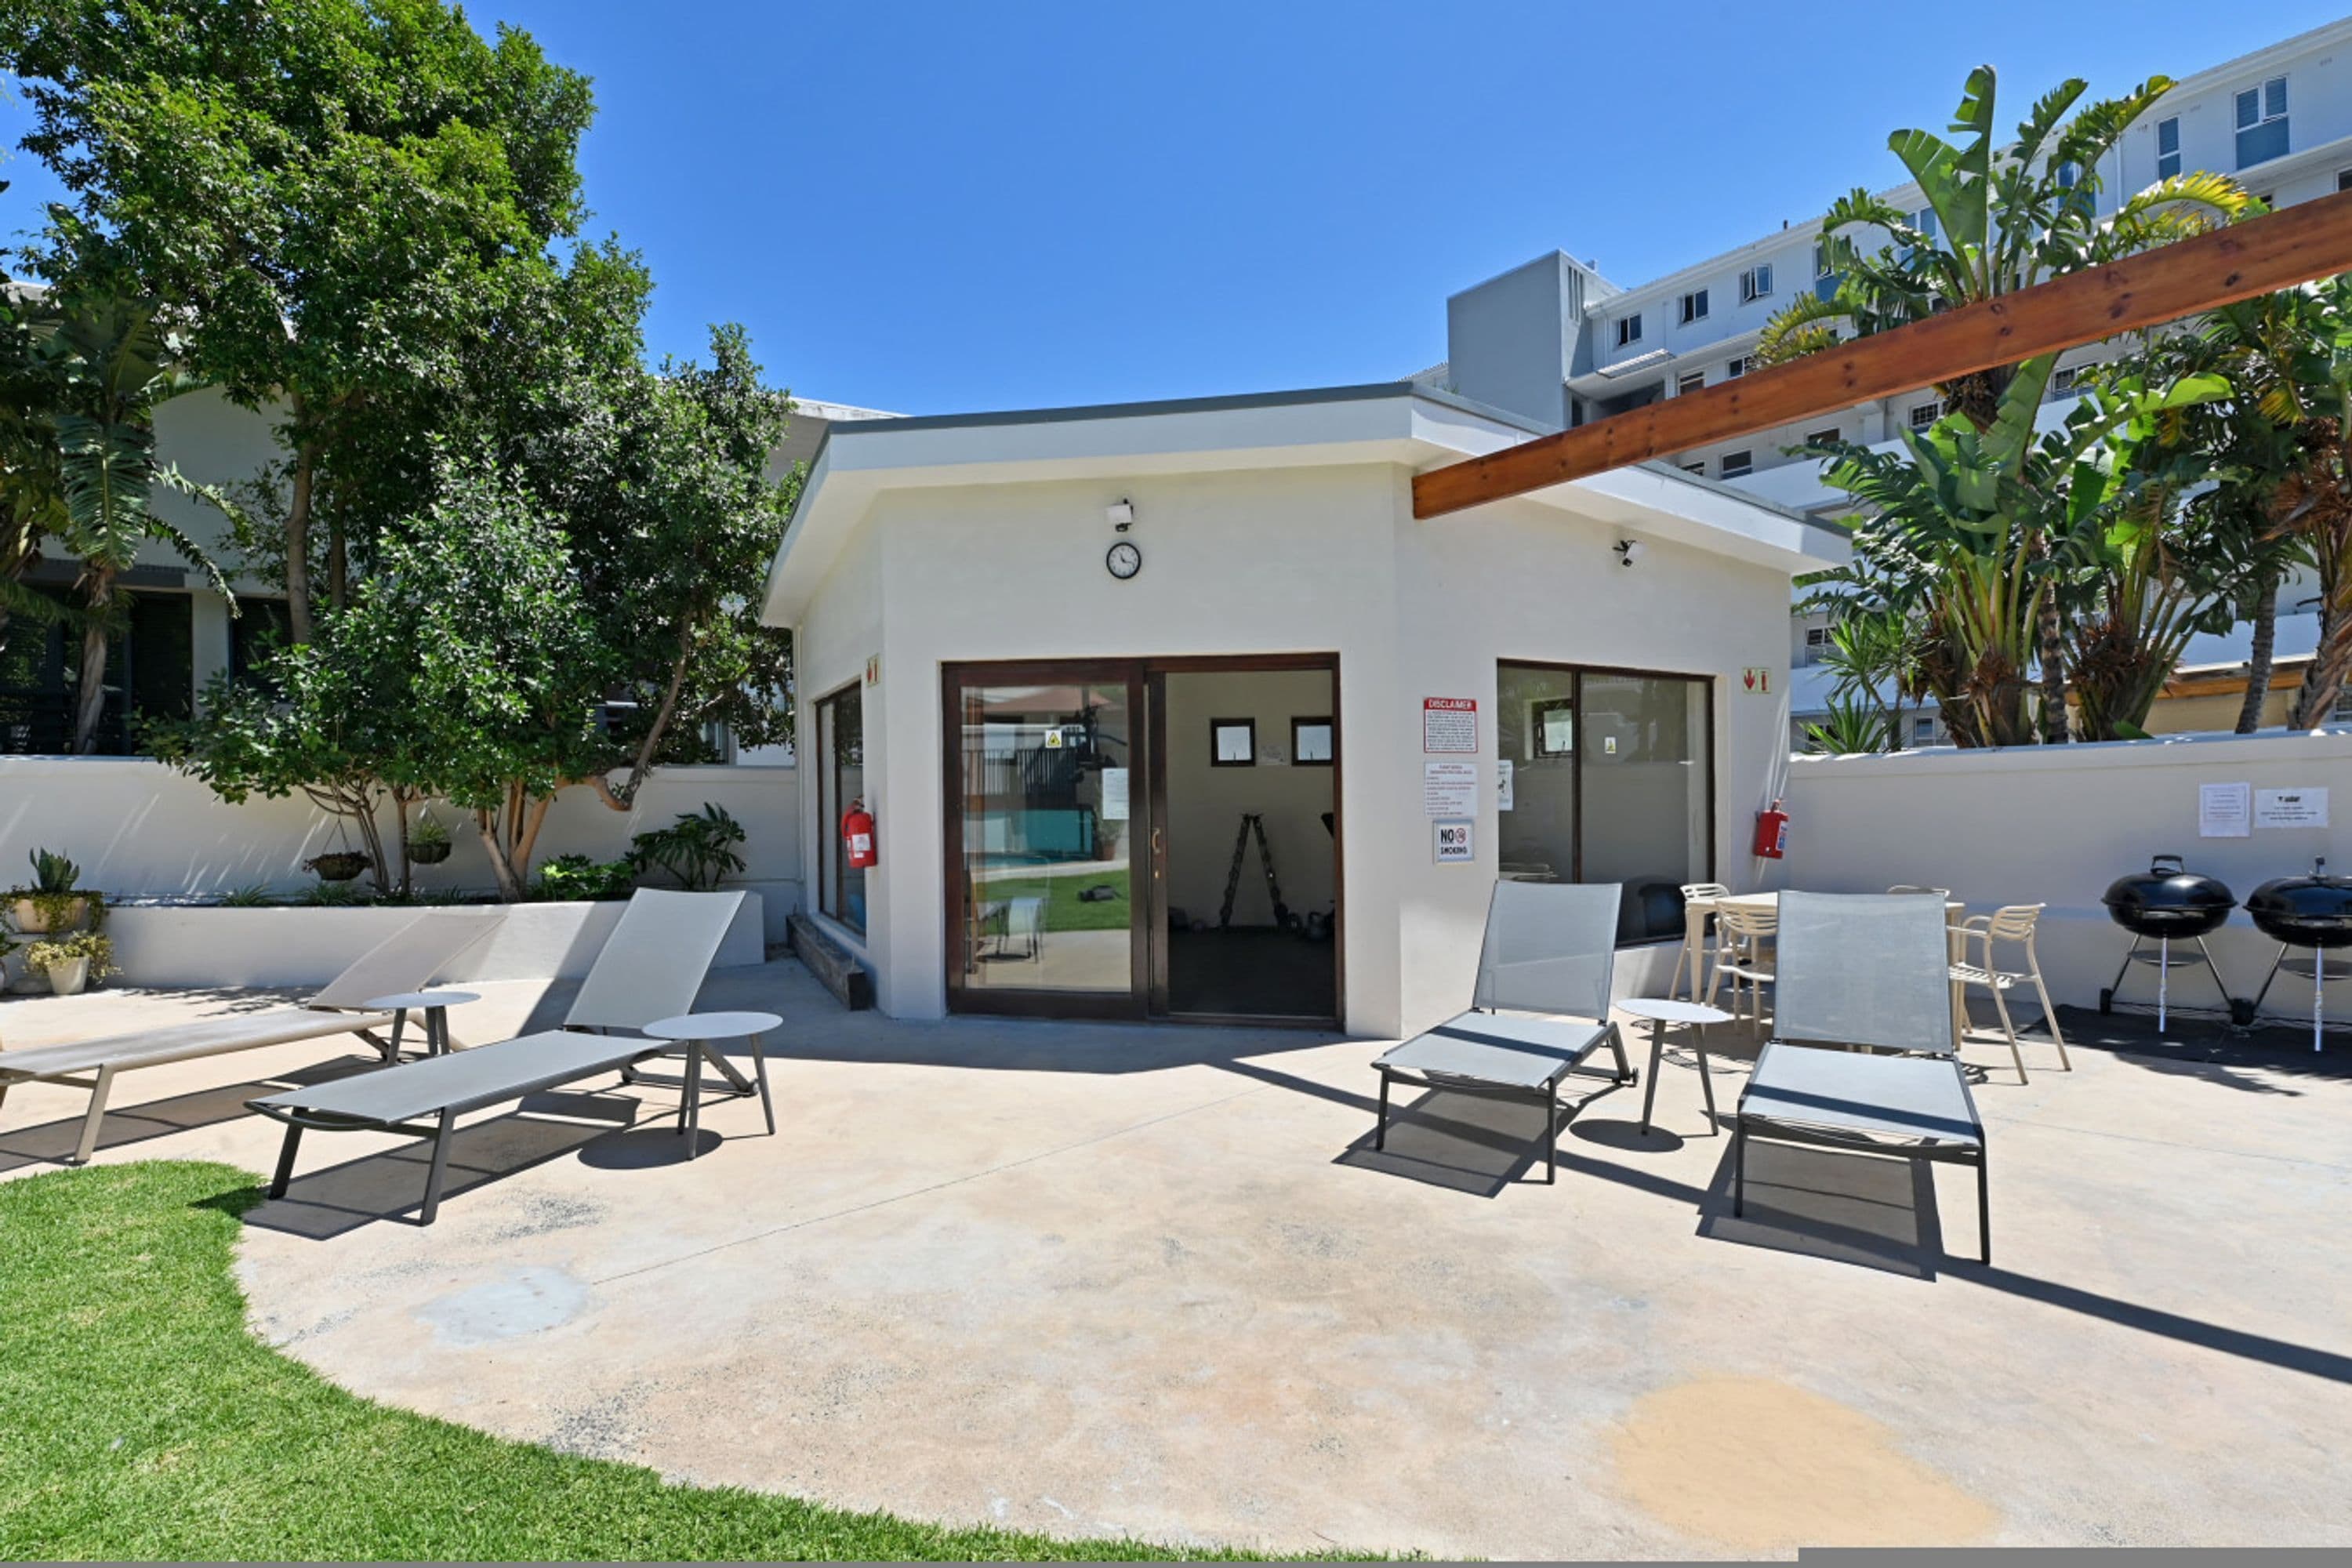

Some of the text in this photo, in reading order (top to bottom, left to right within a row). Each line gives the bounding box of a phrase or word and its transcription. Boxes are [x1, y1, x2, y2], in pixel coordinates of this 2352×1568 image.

[1428, 699, 1472, 710] DISCLAIMER
[1441, 829, 1454, 843] NO
[1441, 846, 1468, 855] SMOKING
